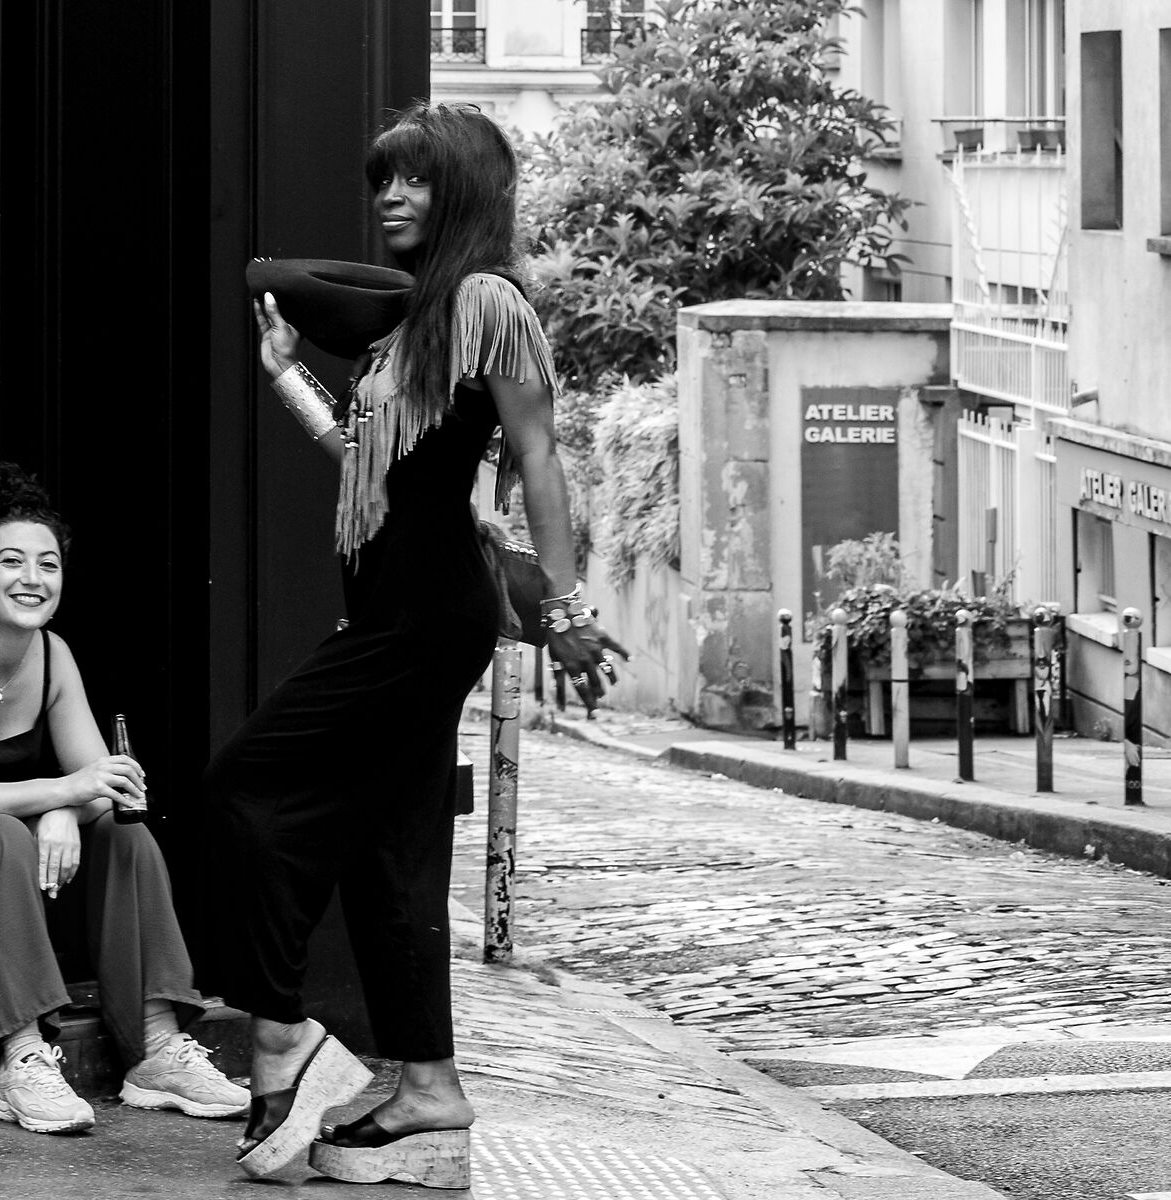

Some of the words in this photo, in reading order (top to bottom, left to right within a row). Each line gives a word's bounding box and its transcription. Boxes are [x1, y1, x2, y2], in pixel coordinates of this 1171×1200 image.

[804, 404, 895, 422] ATELIER
[804, 426, 896, 444] GALERIE
[1079, 467, 1123, 510] ATELIER
